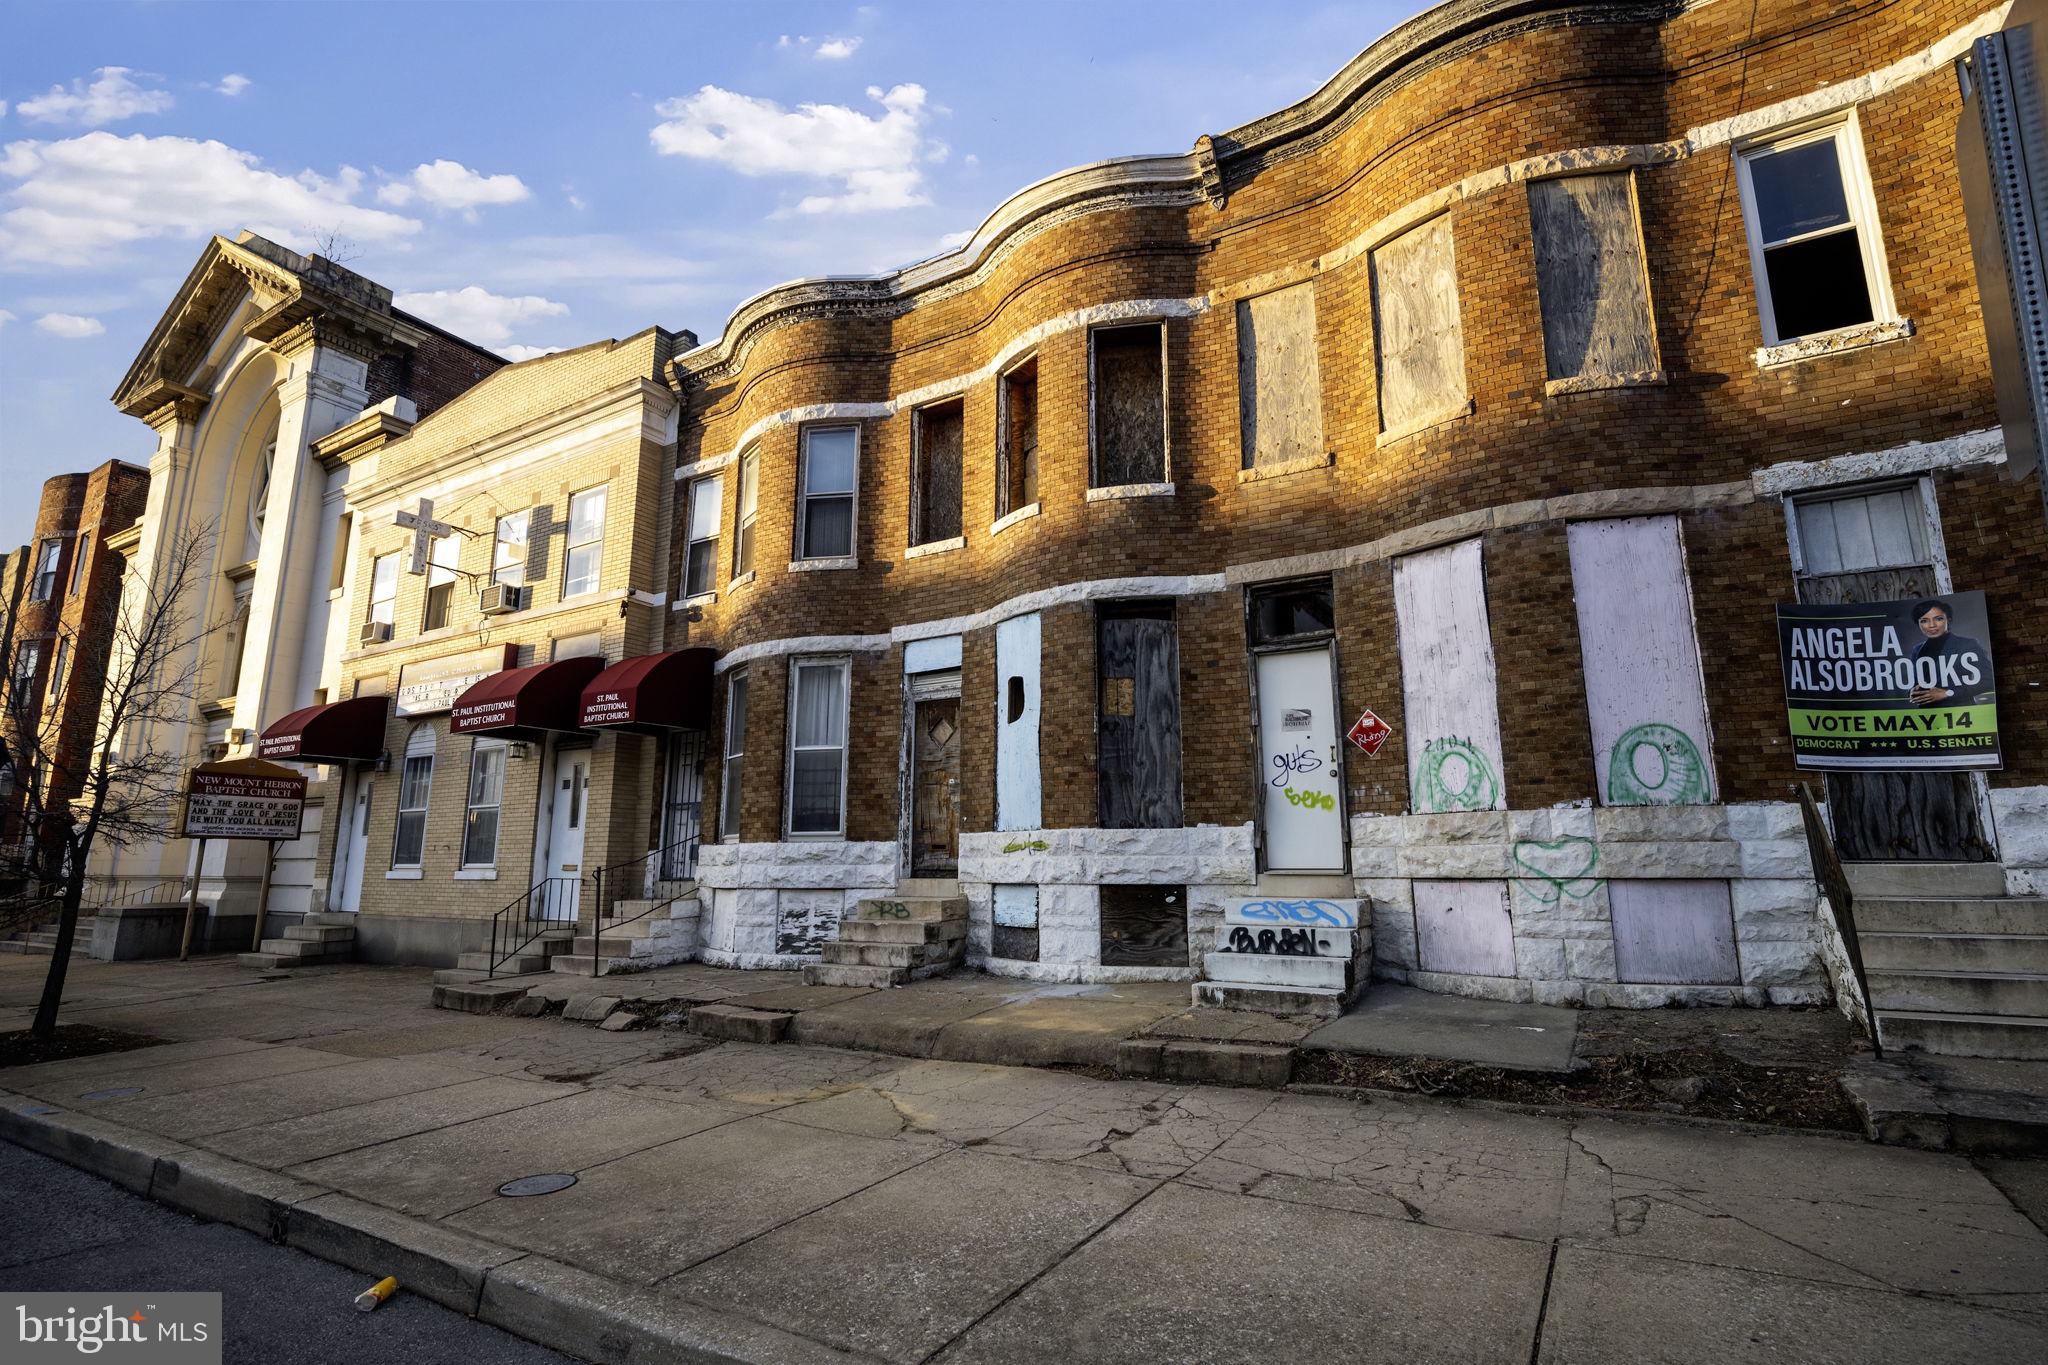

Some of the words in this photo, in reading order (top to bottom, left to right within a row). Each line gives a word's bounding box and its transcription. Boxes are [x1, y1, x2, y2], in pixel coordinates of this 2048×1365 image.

[1791, 625, 1903, 659] ANGELA
[1791, 651, 1981, 692] ALSOBROOKS
[605, 693, 619, 702] PAUL
[460, 707, 473, 716] PAUL
[474, 700, 515, 714] INSTITUTIONAL
[587, 702, 628, 713] INSTITUTIONAL
[460, 716, 482, 727] BAPTIST
[482, 713, 505, 724] CHURCH
[584, 714, 606, 723] BAPTIST
[606, 711, 630, 720] CHURCH
[1806, 714, 1867, 733] VOTE
[1873, 713, 1939, 732] MAY
[1944, 711, 1973, 730] 14
[1796, 737, 1860, 750] DEMOCRAT
[1907, 739, 1935, 749] U.S.
[1938, 735, 1993, 748] SENATE
[264, 746, 279, 755] BAPTIST
[279, 744, 295, 752] CHURCH
[196, 775, 221, 784] NEW
[224, 777, 261, 787] MOUNT
[264, 780, 303, 789] HEBRON
[205, 785, 247, 795] BAPTIST
[250, 788, 291, 797] CHURCH
[218, 800, 233, 808] THE
[237, 801, 265, 809] GRACE
[268, 802, 278, 810] OF
[282, 803, 299, 811] GOD
[191, 807, 208, 815] AND
[212, 807, 227, 816] THE
[233, 809, 255, 817] LOVE
[260, 810, 270, 818] OF
[273, 811, 298, 819] JESUS
[191, 815, 201, 823] BE
[203, 816, 225, 824] WITH
[227, 817, 244, 825] YOU
[246, 818, 264, 826] ALL
[264, 818, 296, 827] ALWAYS
